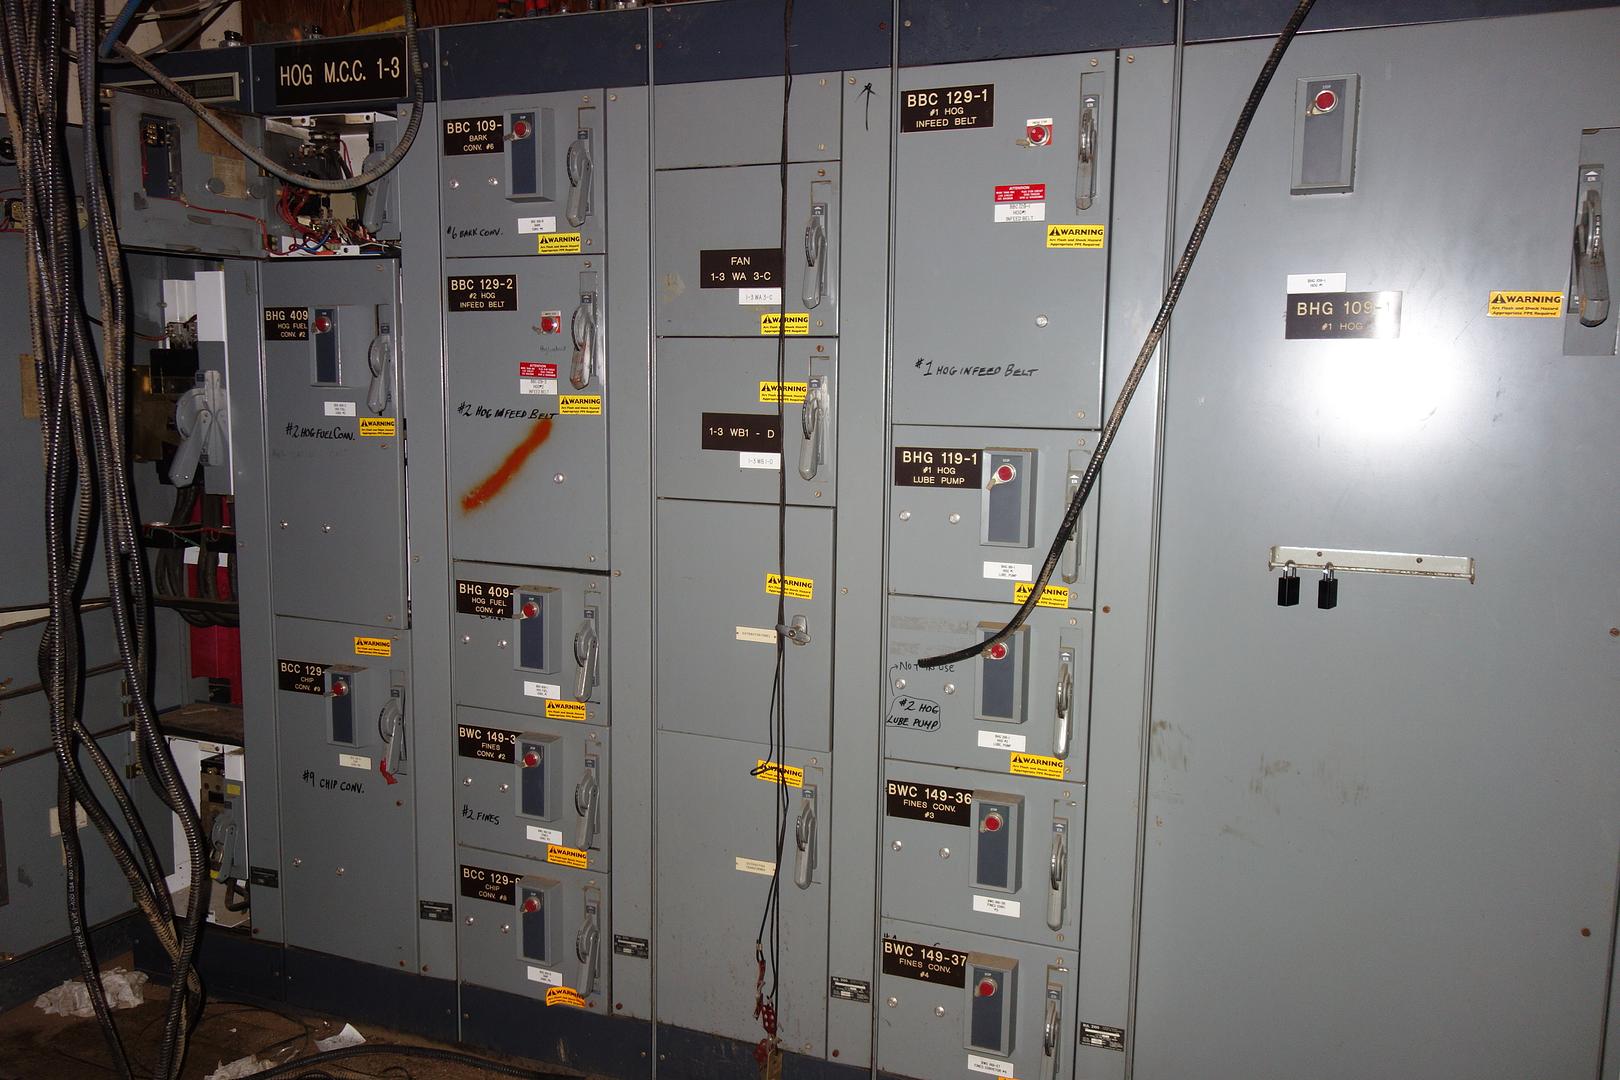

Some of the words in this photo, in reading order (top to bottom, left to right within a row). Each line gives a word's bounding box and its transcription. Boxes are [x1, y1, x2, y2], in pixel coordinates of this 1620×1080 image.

[280, 65, 312, 87] HOG
[325, 59, 366, 83] M.C.C.
[377, 56, 400, 79] 1-3
[908, 93, 938, 107] BBC
[946, 89, 988, 104] 129-1
[447, 121, 470, 134] BBC
[477, 120, 502, 131] 109-
[916, 119, 949, 128] INFEED
[955, 117, 976, 125] BELT
[731, 257, 750, 265] FAN
[710, 273, 725, 281] 1-3
[754, 272, 771, 280] 3-C
[451, 280, 473, 290] BBC
[480, 279, 513, 290] 129-2
[1297, 302, 1333, 316] BHG
[1344, 301, 1390, 315] 109-1
[266, 310, 287, 321] BHG
[290, 310, 308, 321] 409
[914, 358, 933, 376] #1
[936, 365, 956, 376] HOG
[960, 366, 1001, 376] INFEED
[1005, 364, 1039, 377] BELT
[457, 401, 472, 416] #2
[475, 409, 492, 418] HOG
[495, 409, 527, 419] INFEED
[528, 409, 560, 420] BELT
[709, 428, 723, 436] 1-3
[730, 428, 749, 437] WB1
[768, 430, 774, 438] D
[903, 451, 932, 464] BHG
[941, 452, 977, 465] 119-1
[459, 584, 482, 595] BHG
[488, 587, 514, 598] 409-
[1028, 587, 1068, 596] WRNING
[281, 663, 301, 675] BCC
[305, 664, 325, 676] 129-
[554, 703, 585, 711] WARNING
[899, 698, 915, 711] #2
[919, 704, 939, 714] HOG
[886, 715, 909, 726] LUBE
[913, 719, 938, 729] PUMP
[459, 727, 481, 740] BWC
[1023, 757, 1063, 768] WARNING
[302, 770, 315, 786] #9
[320, 779, 337, 790] CHIP
[889, 783, 917, 796] BWC
[925, 789, 972, 805] 149-36
[904, 800, 927, 808] FINES
[462, 805, 475, 820] #2
[477, 812, 500, 825] FINES
[556, 849, 586, 859] WARNING
[464, 868, 485, 880] BCC
[884, 941, 913, 957] BWC
[921, 950, 967, 967] 149-37
[899, 958, 922, 968] FINES
